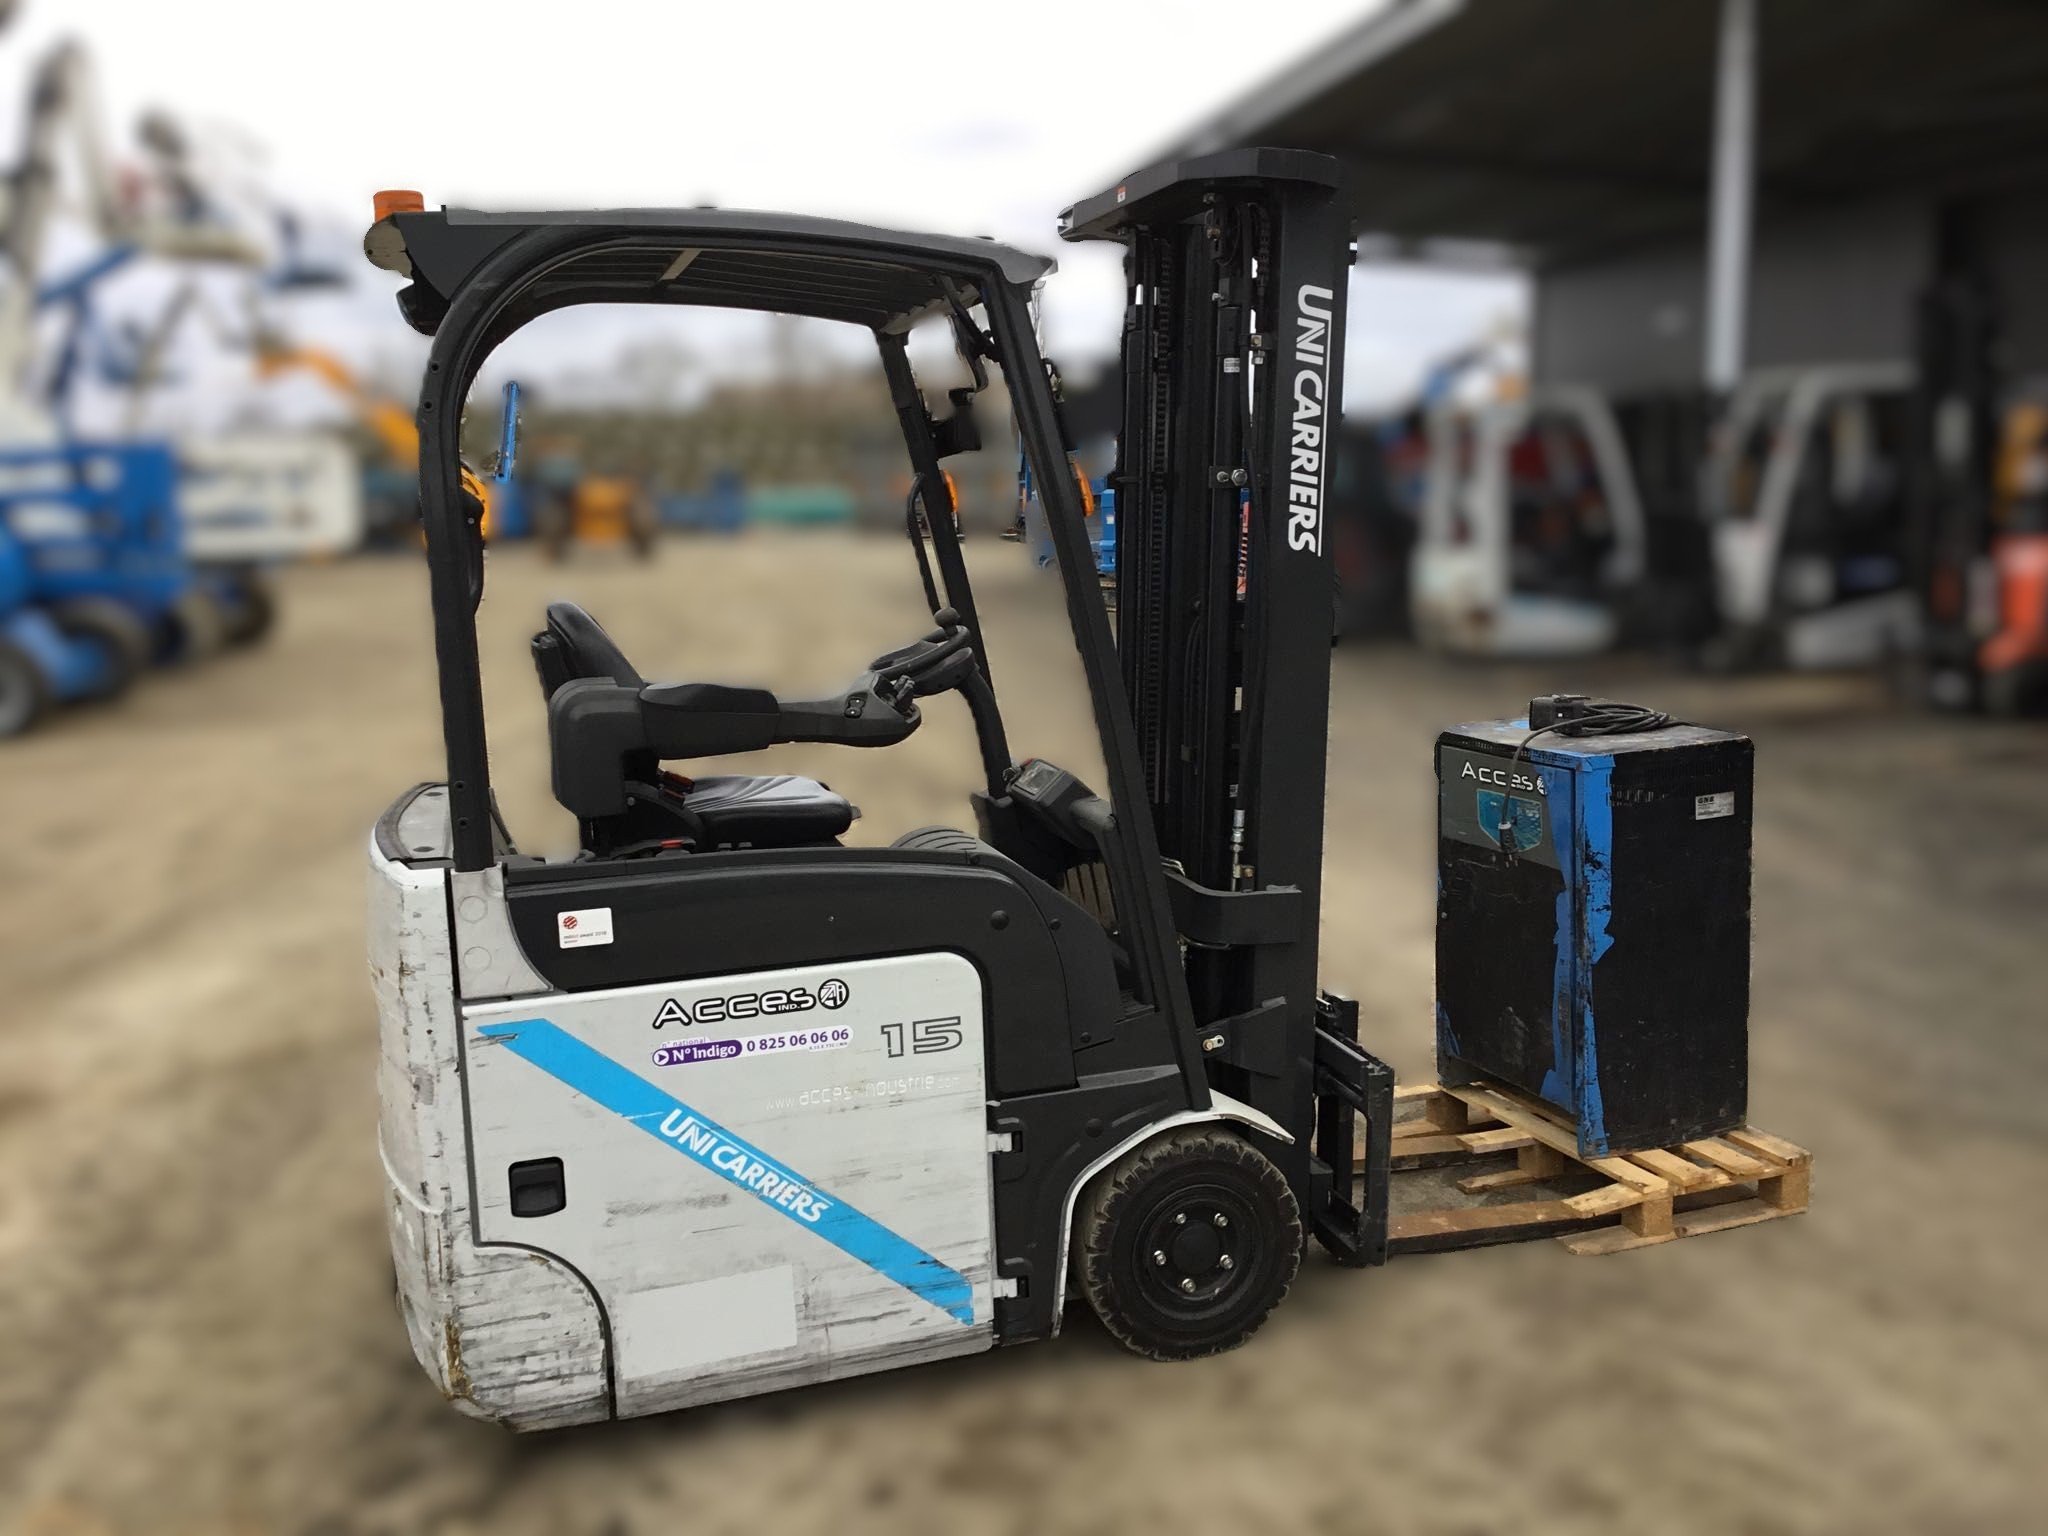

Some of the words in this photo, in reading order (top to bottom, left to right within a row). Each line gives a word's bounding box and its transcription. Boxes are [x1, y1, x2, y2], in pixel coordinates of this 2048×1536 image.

[1288, 284, 1333, 553] UNICARRIERS
[672, 1036, 706, 1047] national
[672, 1048, 691, 1062] N°
[692, 1044, 737, 1059] Indigo
[746, 1040, 755, 1051] 0
[759, 1036, 786, 1050] 825
[789, 1033, 807, 1047] 06
[810, 1031, 828, 1044] 06
[831, 1028, 849, 1041] 06
[880, 1015, 963, 1058] 15
[659, 1108, 829, 1222] UNICARRIERS
